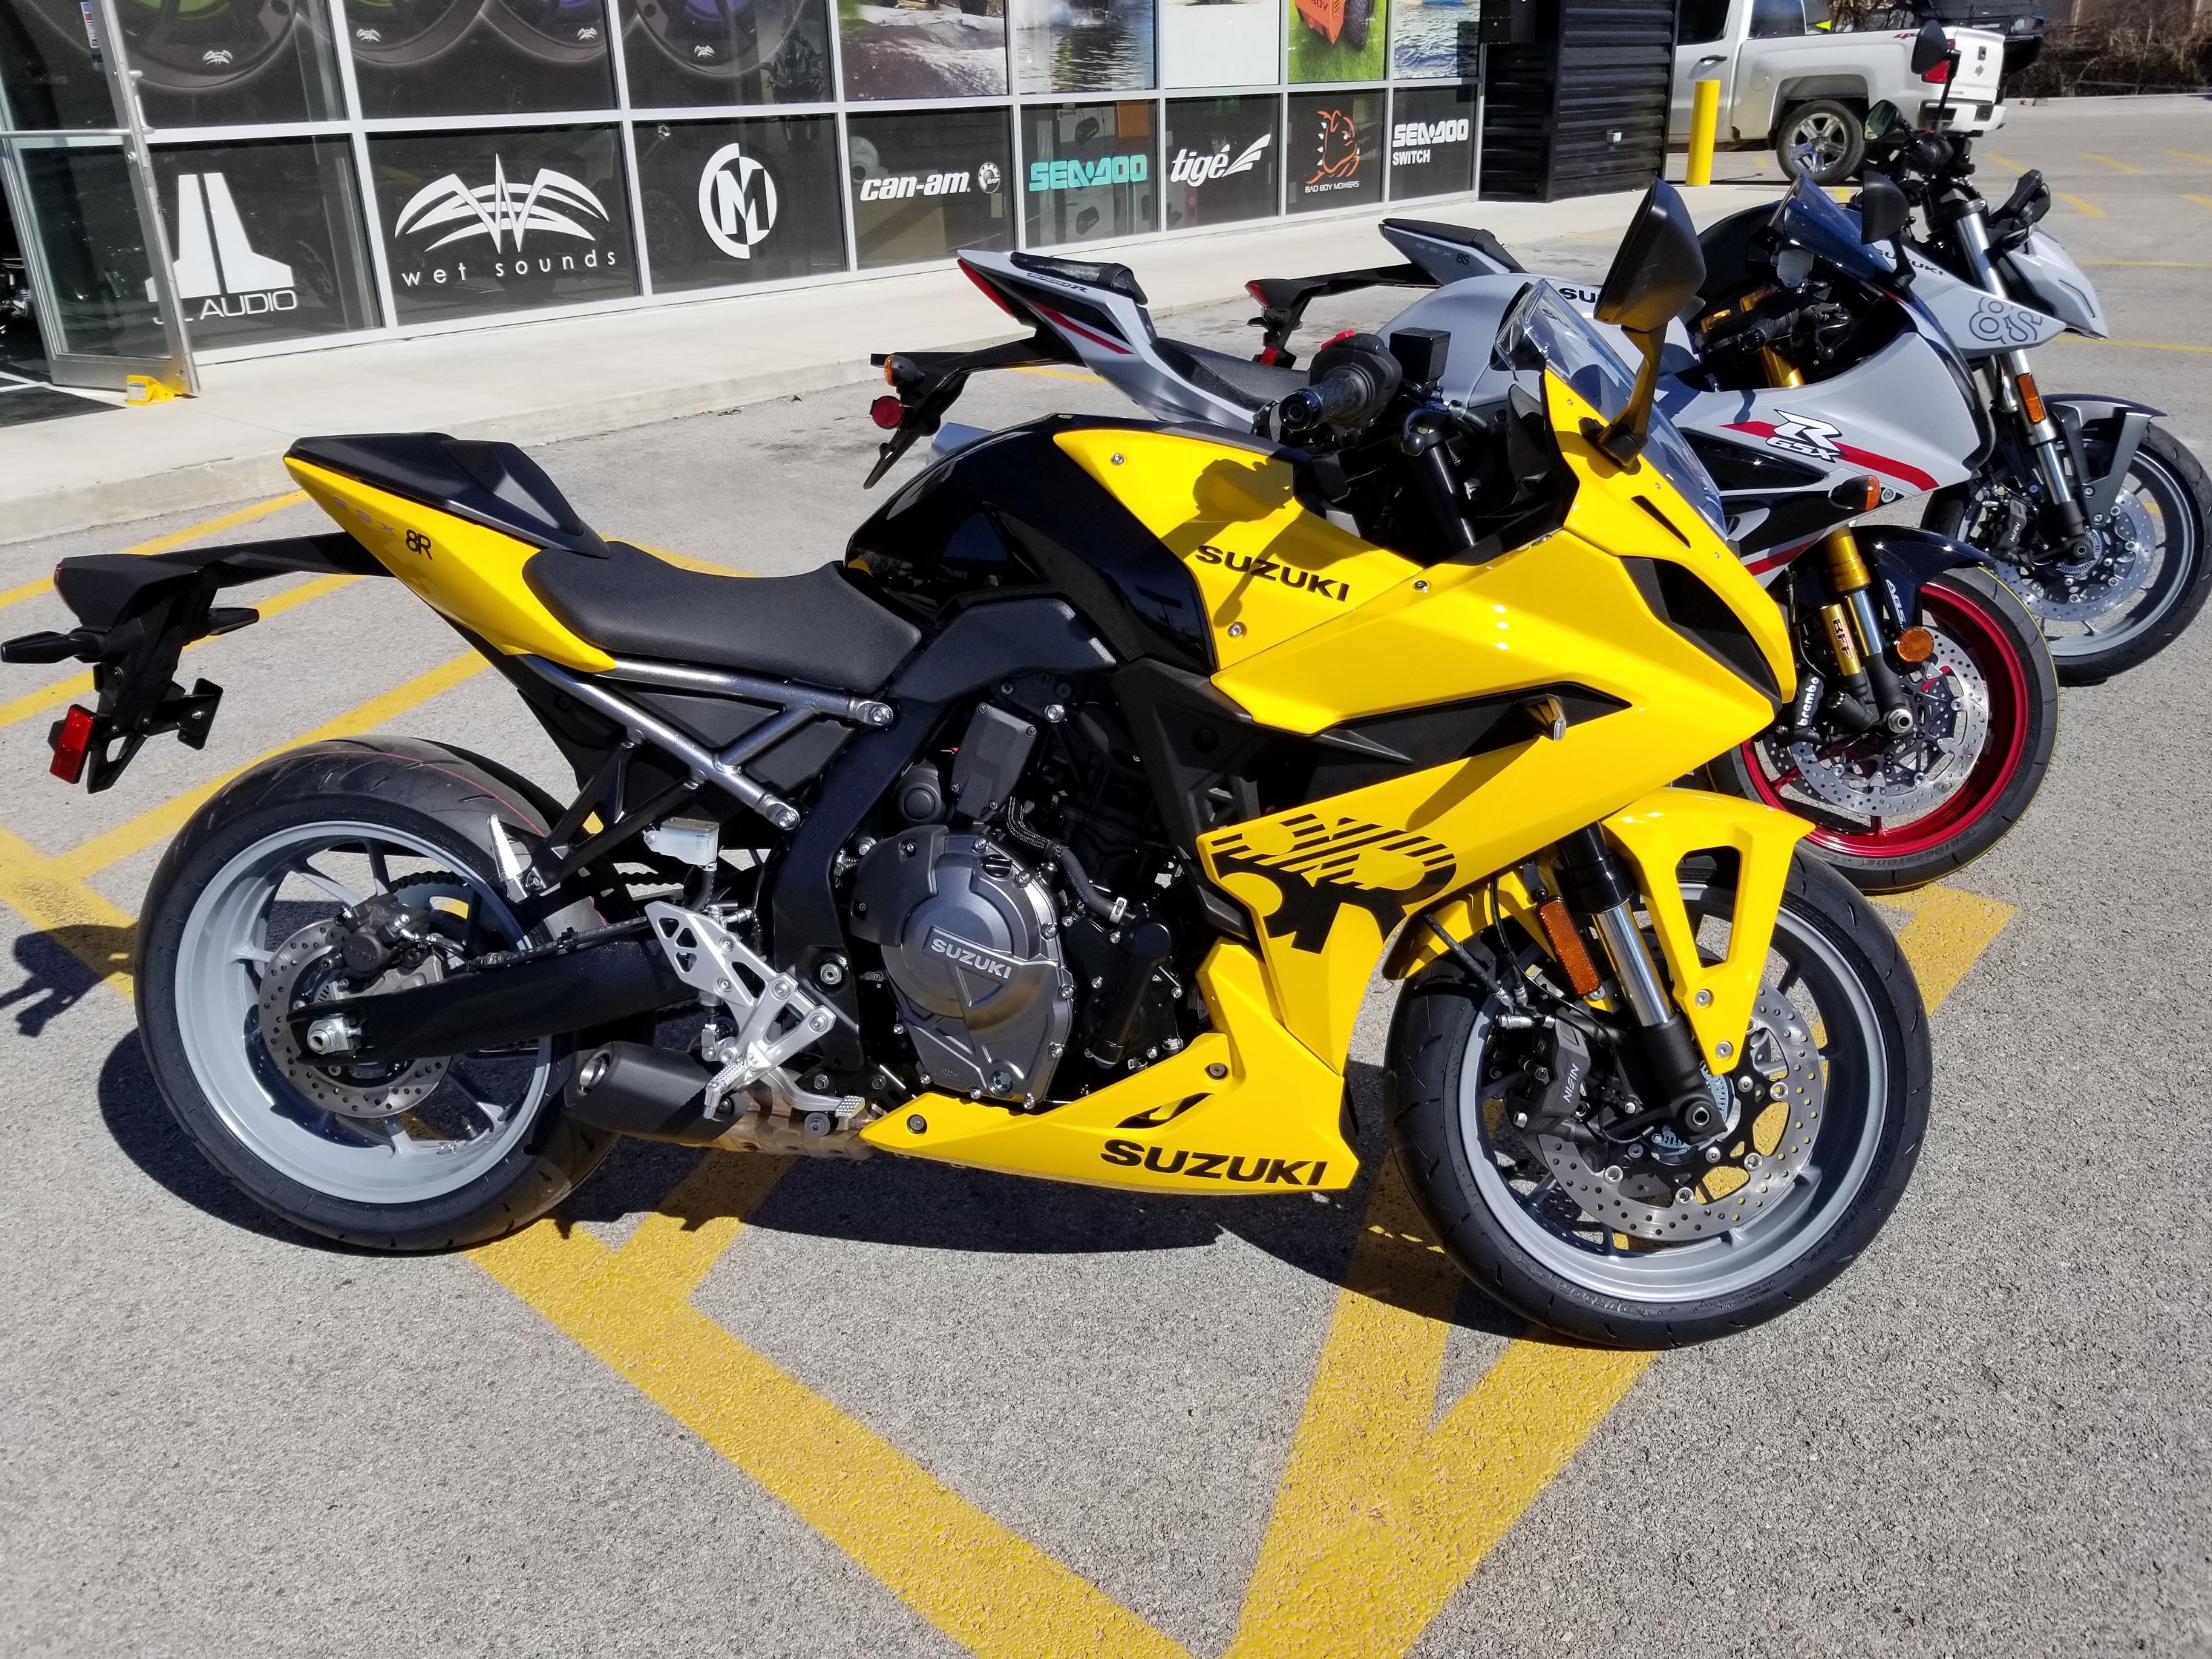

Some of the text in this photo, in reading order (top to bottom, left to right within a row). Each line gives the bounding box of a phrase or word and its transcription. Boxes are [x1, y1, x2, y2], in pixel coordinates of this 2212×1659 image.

[1392, 149, 1431, 165] SWITCH
[1319, 183, 1333, 191] BOY
[1333, 180, 1360, 190] MOWERS
[401, 249, 616, 287] wet sounds
[1456, 253, 1471, 266] 8S
[1876, 249, 1944, 276] SUUKI
[200, 289, 298, 321] AUDIO
[1765, 436, 1842, 464] GSX
[405, 529, 434, 560] 8R
[1195, 544, 1351, 603] SUZUKI
[1885, 579, 1906, 626] ABS
[1832, 618, 1853, 660] BFF
[1797, 676, 1820, 726] brembo
[930, 937, 1012, 979] SUZUKI
[1101, 1139, 1328, 1186] SUZUKI
